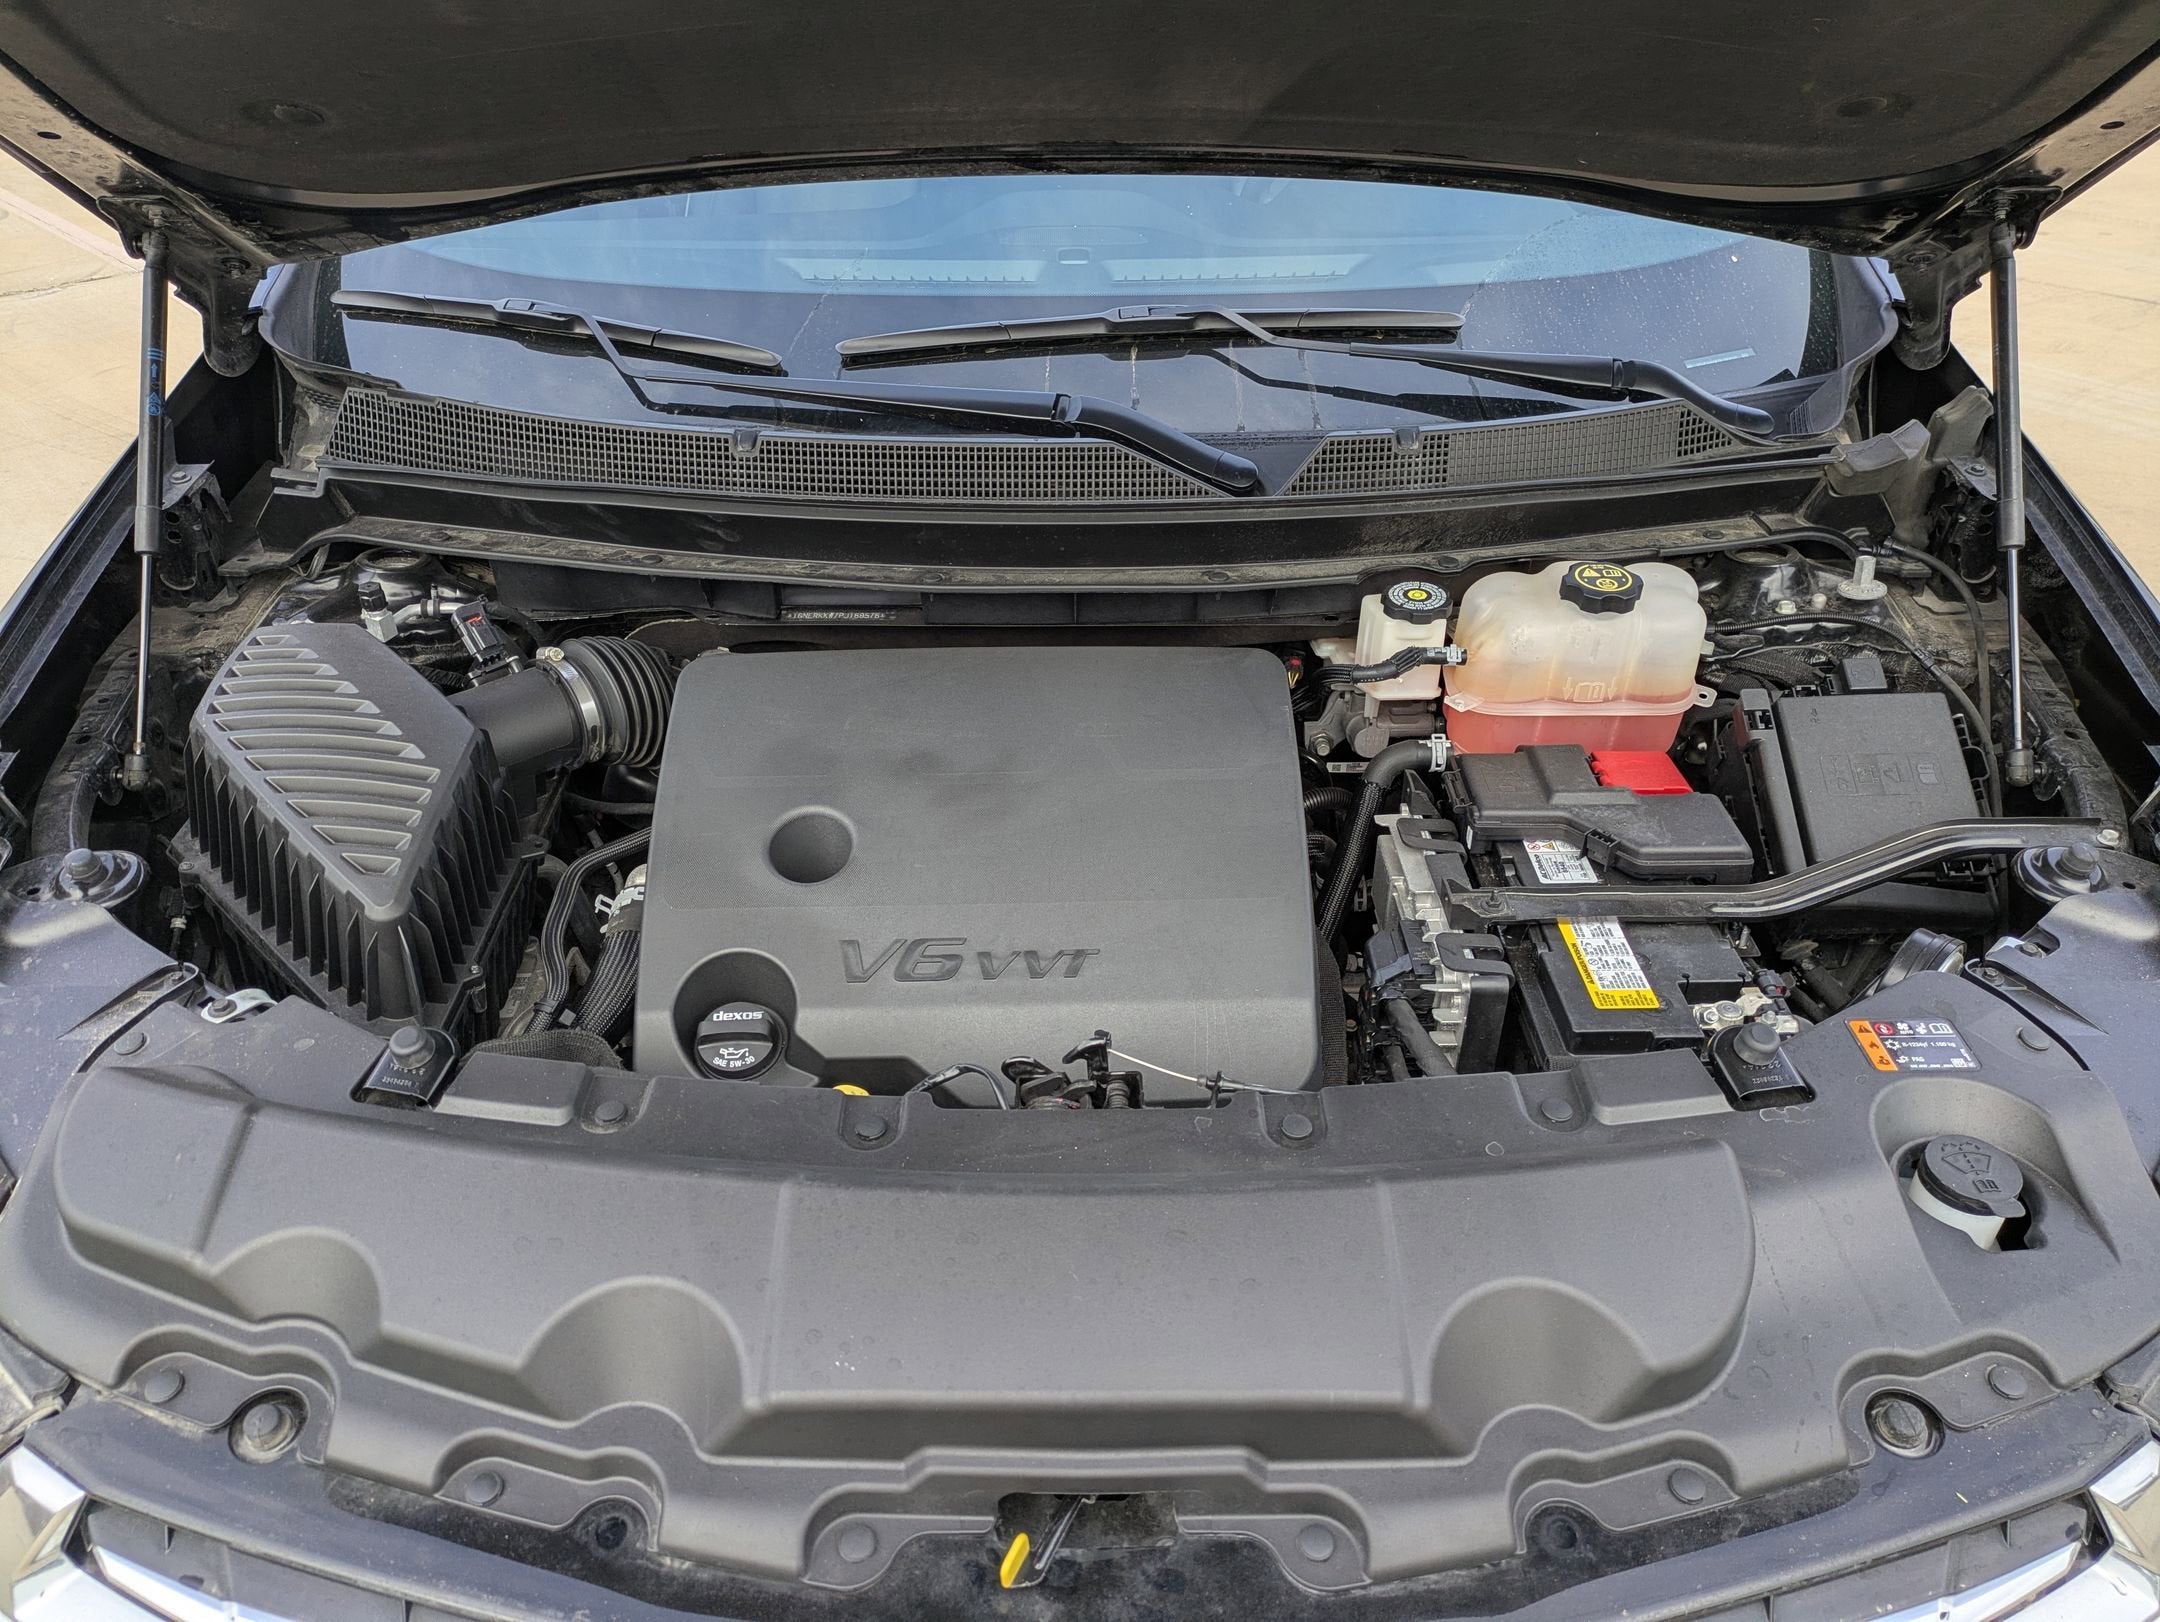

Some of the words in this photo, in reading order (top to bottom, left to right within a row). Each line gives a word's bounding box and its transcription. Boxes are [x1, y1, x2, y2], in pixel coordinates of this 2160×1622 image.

[838, 937, 967, 984] V6
[976, 949, 1100, 981] VVT
[713, 1011, 764, 1021] dexos
[713, 1057, 728, 1067] SAE
[730, 1056, 755, 1067] 5W-30
